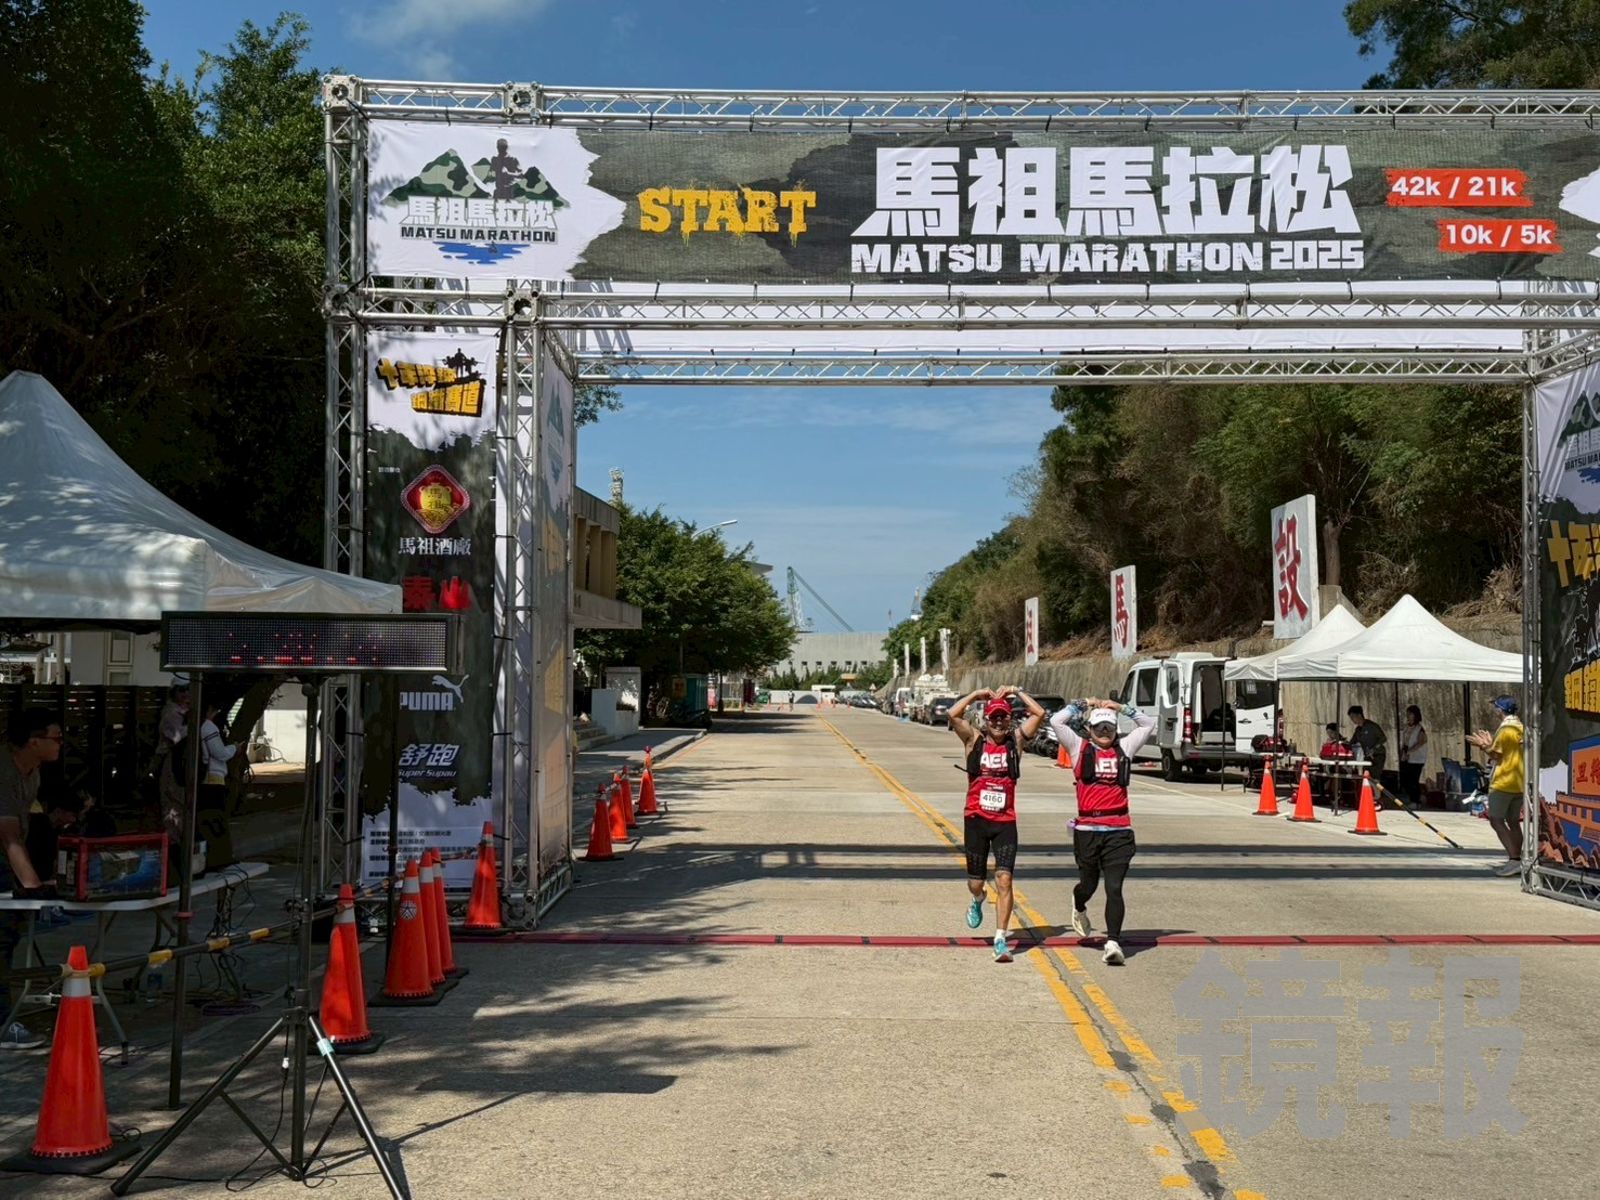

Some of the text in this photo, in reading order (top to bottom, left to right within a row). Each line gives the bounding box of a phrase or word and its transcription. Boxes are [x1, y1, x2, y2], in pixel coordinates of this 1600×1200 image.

[851, 145, 1361, 237] 馬祖馬拉松
[1392, 176, 1517, 199] 42k / 21k
[400, 196, 557, 229] 馬祖馬拉松
[637, 184, 817, 242] START
[401, 226, 556, 243] MATSU MARATHON
[1446, 224, 1552, 247] 10k / 5k
[851, 239, 1365, 273] MATSU MARATHON 2025
[1565, 457, 1587, 471] MATSU
[398, 537, 471, 556] 馬祖酒廠
[1113, 573, 1129, 648] 馬
[400, 692, 453, 711] PUMA
[399, 743, 460, 766] 舒跑
[983, 794, 1003, 804] 4160
